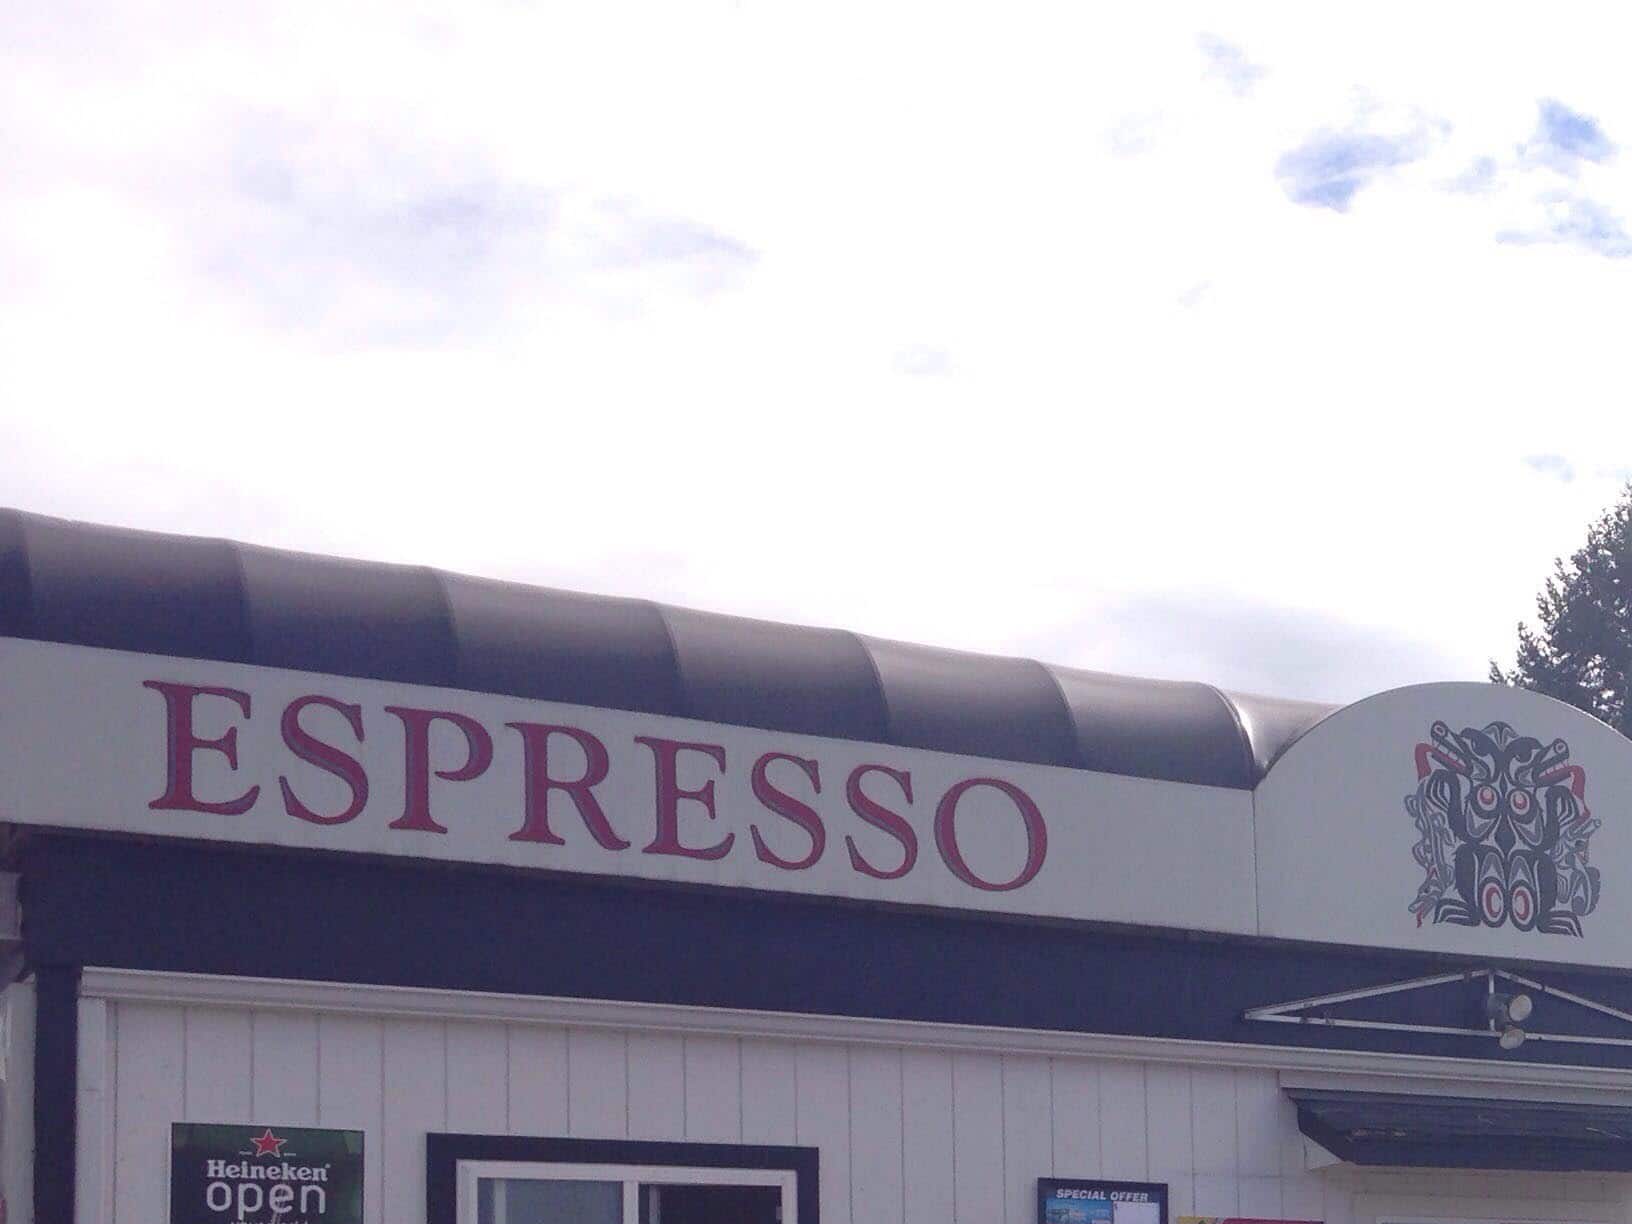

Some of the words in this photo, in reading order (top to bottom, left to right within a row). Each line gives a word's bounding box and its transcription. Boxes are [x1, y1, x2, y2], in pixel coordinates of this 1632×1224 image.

[142, 679, 1049, 892] ESPRESSO
[206, 1159, 329, 1182] Heineken
[206, 1181, 326, 1220] open
[1055, 1188, 1106, 1201] SPECIAL
[1110, 1190, 1149, 1203] OFFER
